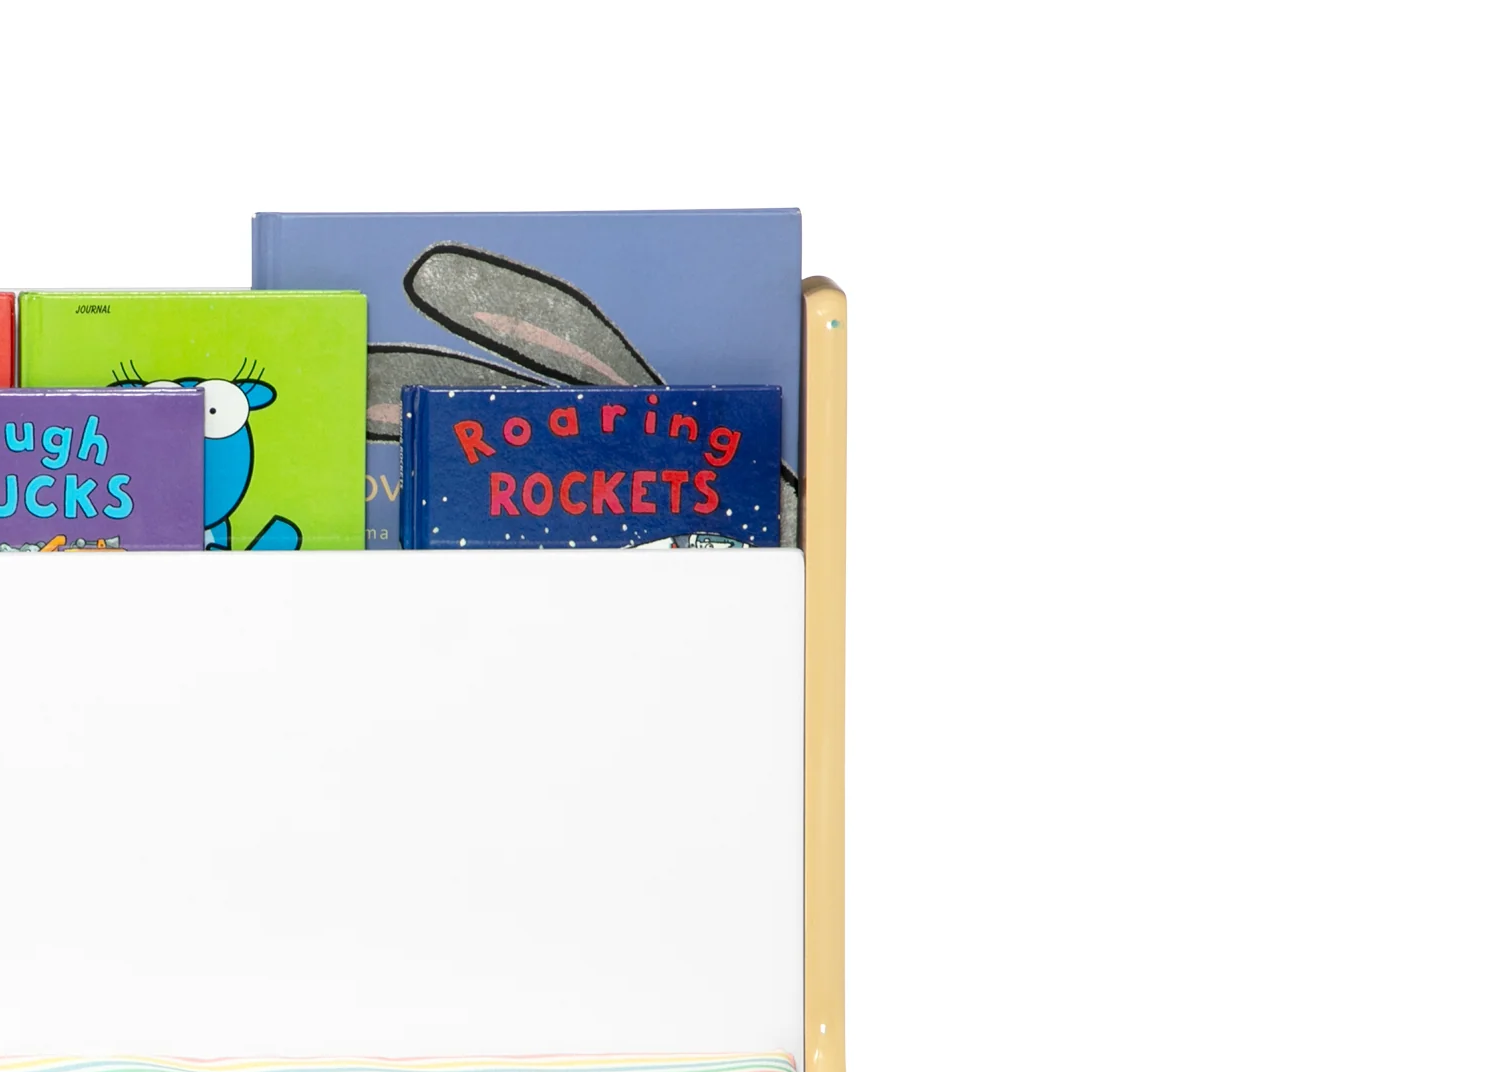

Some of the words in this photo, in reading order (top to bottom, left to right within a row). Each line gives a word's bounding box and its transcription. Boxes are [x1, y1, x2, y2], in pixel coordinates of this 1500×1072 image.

[75, 304, 111, 315] JOURNAL
[453, 393, 742, 467] Roaring
[489, 469, 721, 518] ROCKETS
